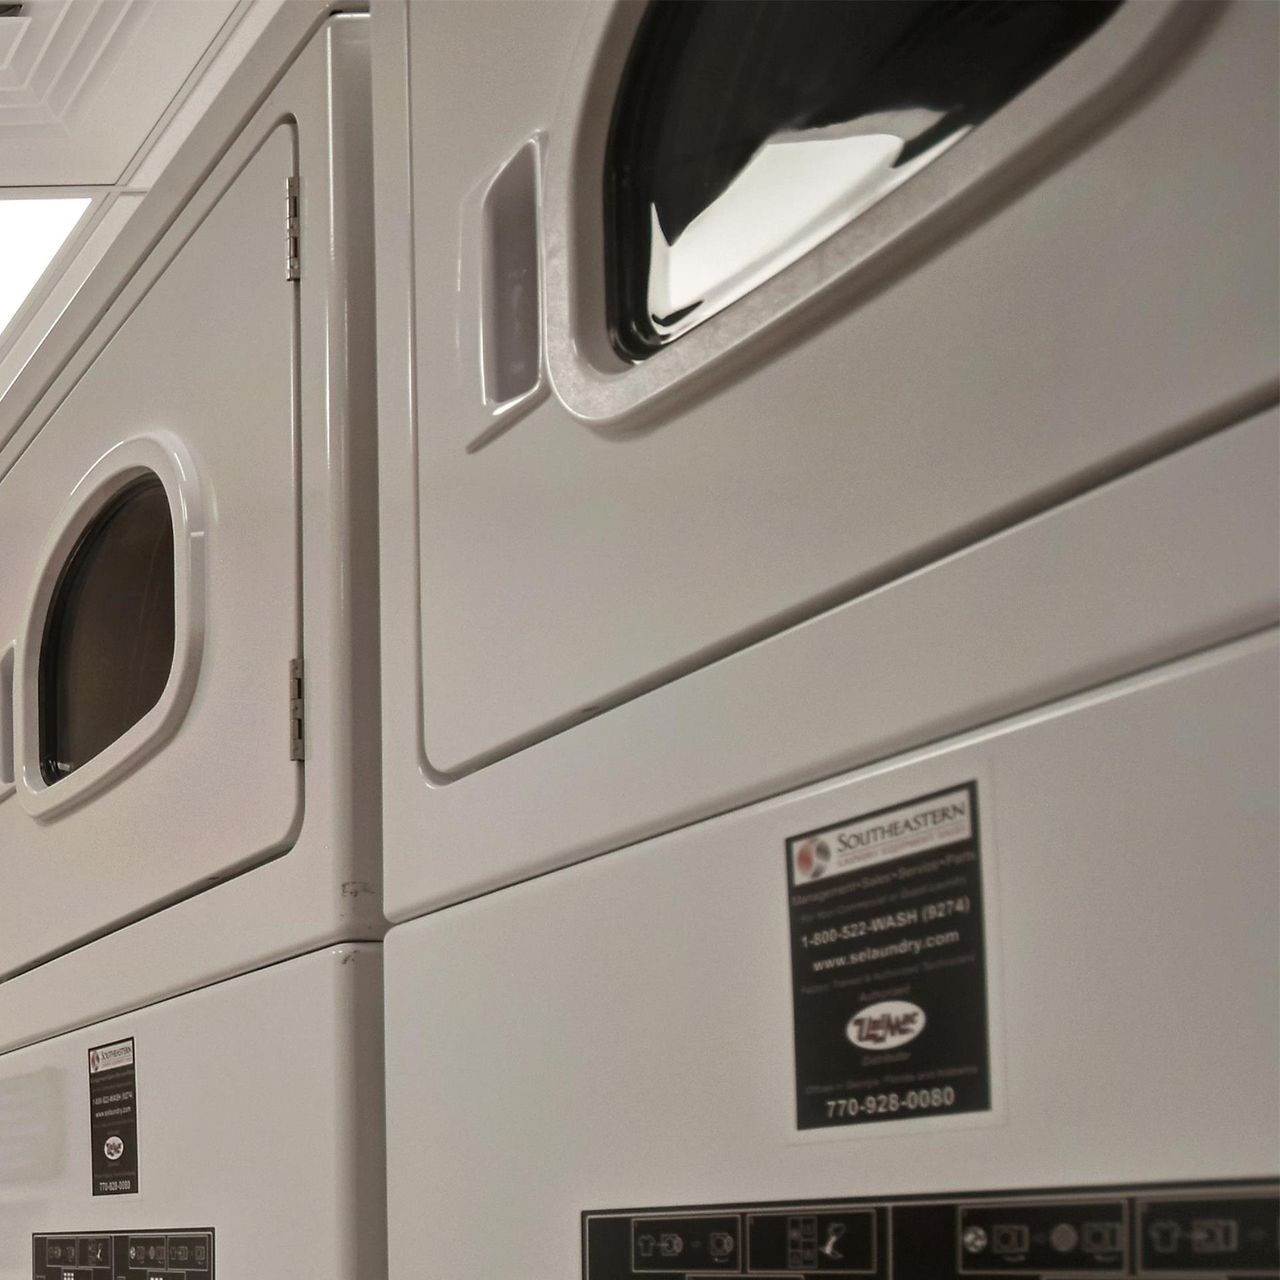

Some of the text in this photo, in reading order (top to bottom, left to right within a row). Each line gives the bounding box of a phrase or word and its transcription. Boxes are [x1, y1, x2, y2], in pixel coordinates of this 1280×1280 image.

[837, 801, 966, 852] SOUTHEASTERN
[801, 909, 918, 949] 1-800-522-WASH
[922, 895, 971, 923] (9274)
[812, 930, 960, 971] www.selaundry.com
[826, 1086, 956, 1119] 770-928-0080
